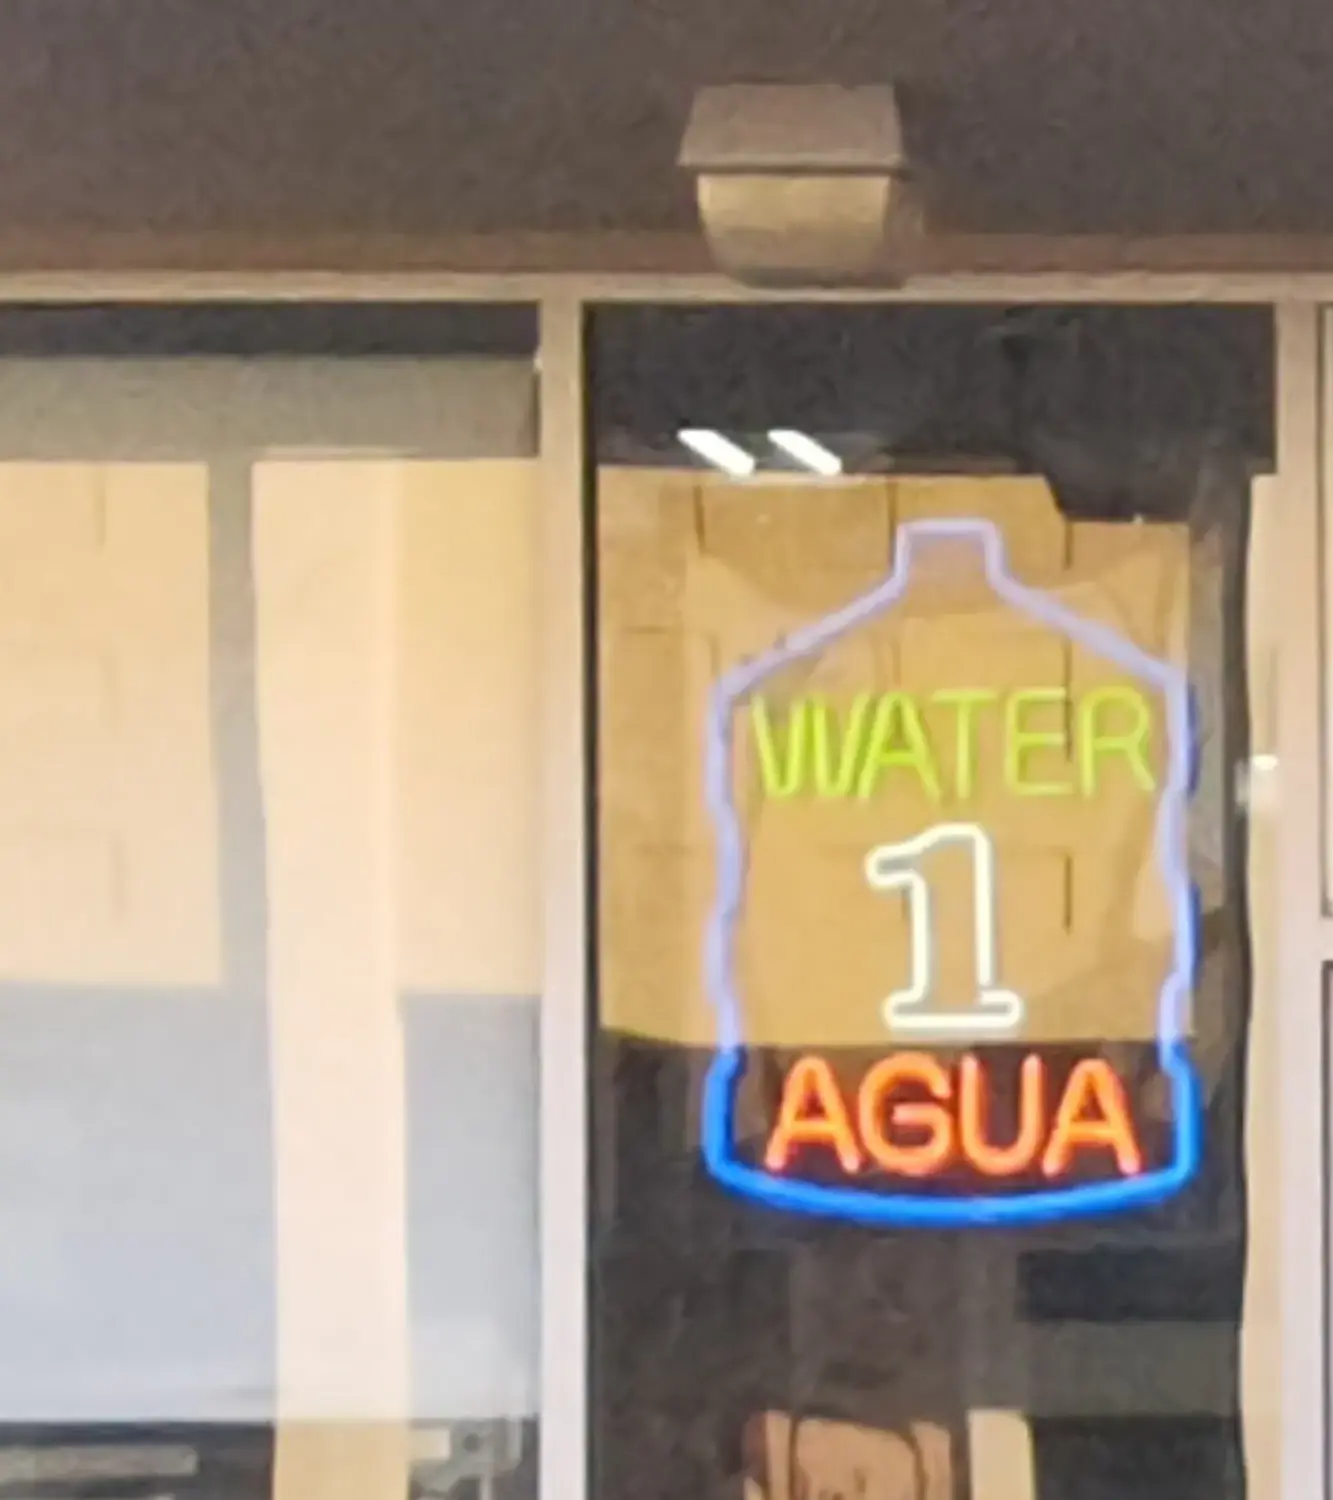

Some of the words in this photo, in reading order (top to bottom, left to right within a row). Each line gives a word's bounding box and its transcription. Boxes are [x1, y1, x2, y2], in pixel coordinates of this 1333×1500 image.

[752, 685, 1157, 802] WATER
[864, 821, 1028, 1036] 1
[765, 1052, 1142, 1178] AGUA
